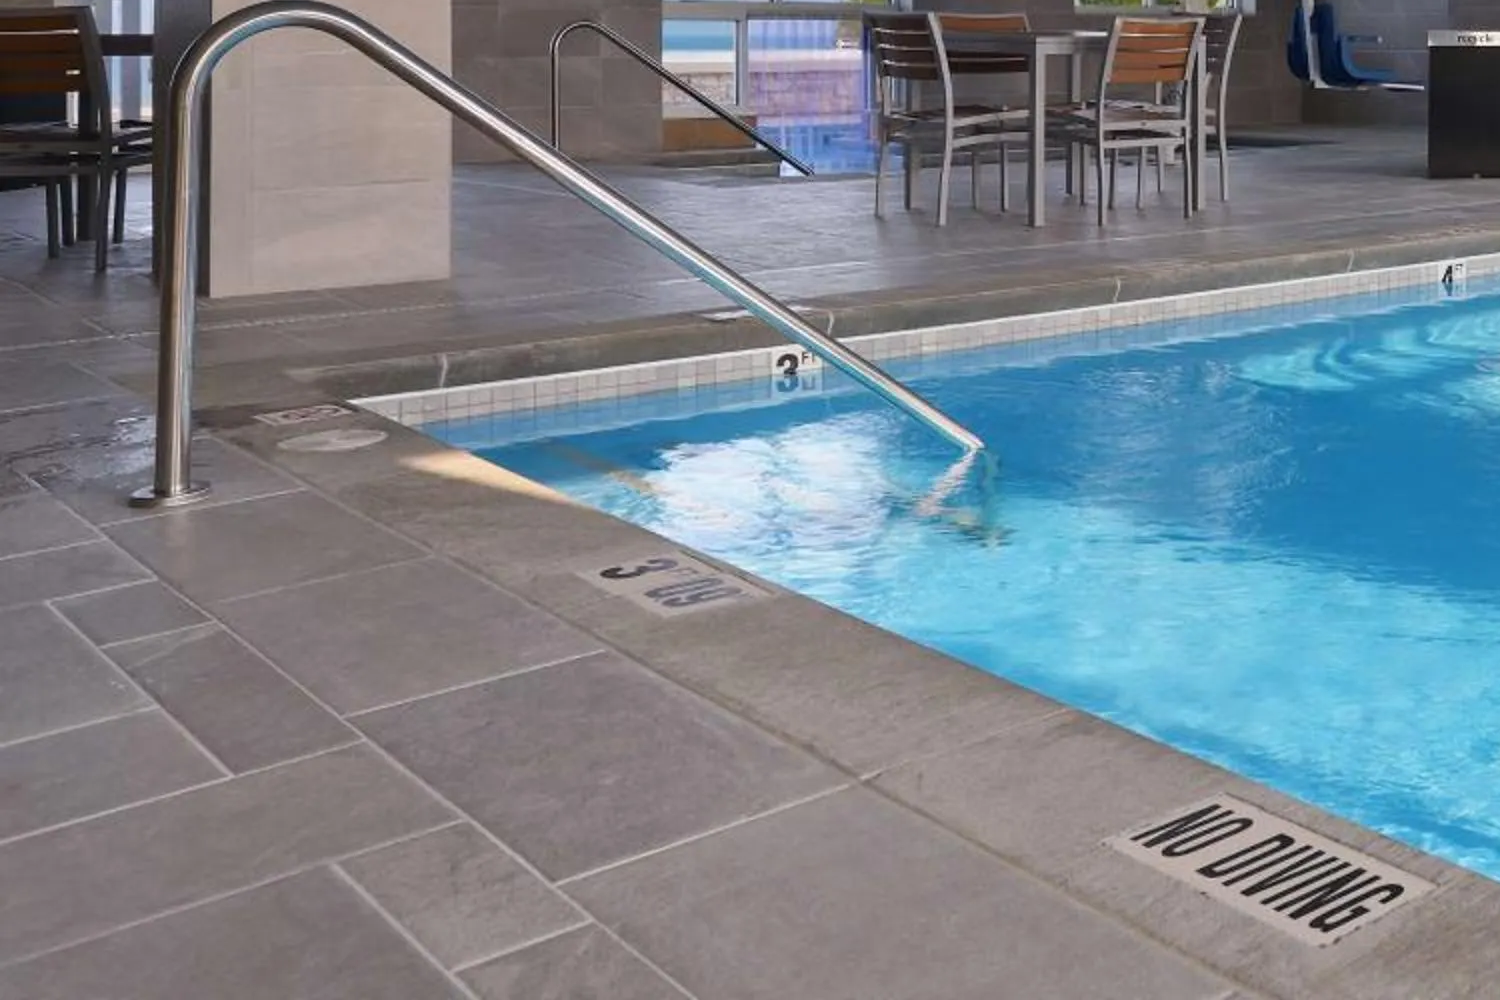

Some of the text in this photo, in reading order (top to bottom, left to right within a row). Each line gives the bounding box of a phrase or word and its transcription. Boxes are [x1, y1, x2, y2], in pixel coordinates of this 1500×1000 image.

[600, 558, 679, 580] 3
[1130, 803, 1405, 934] NO DIVING
